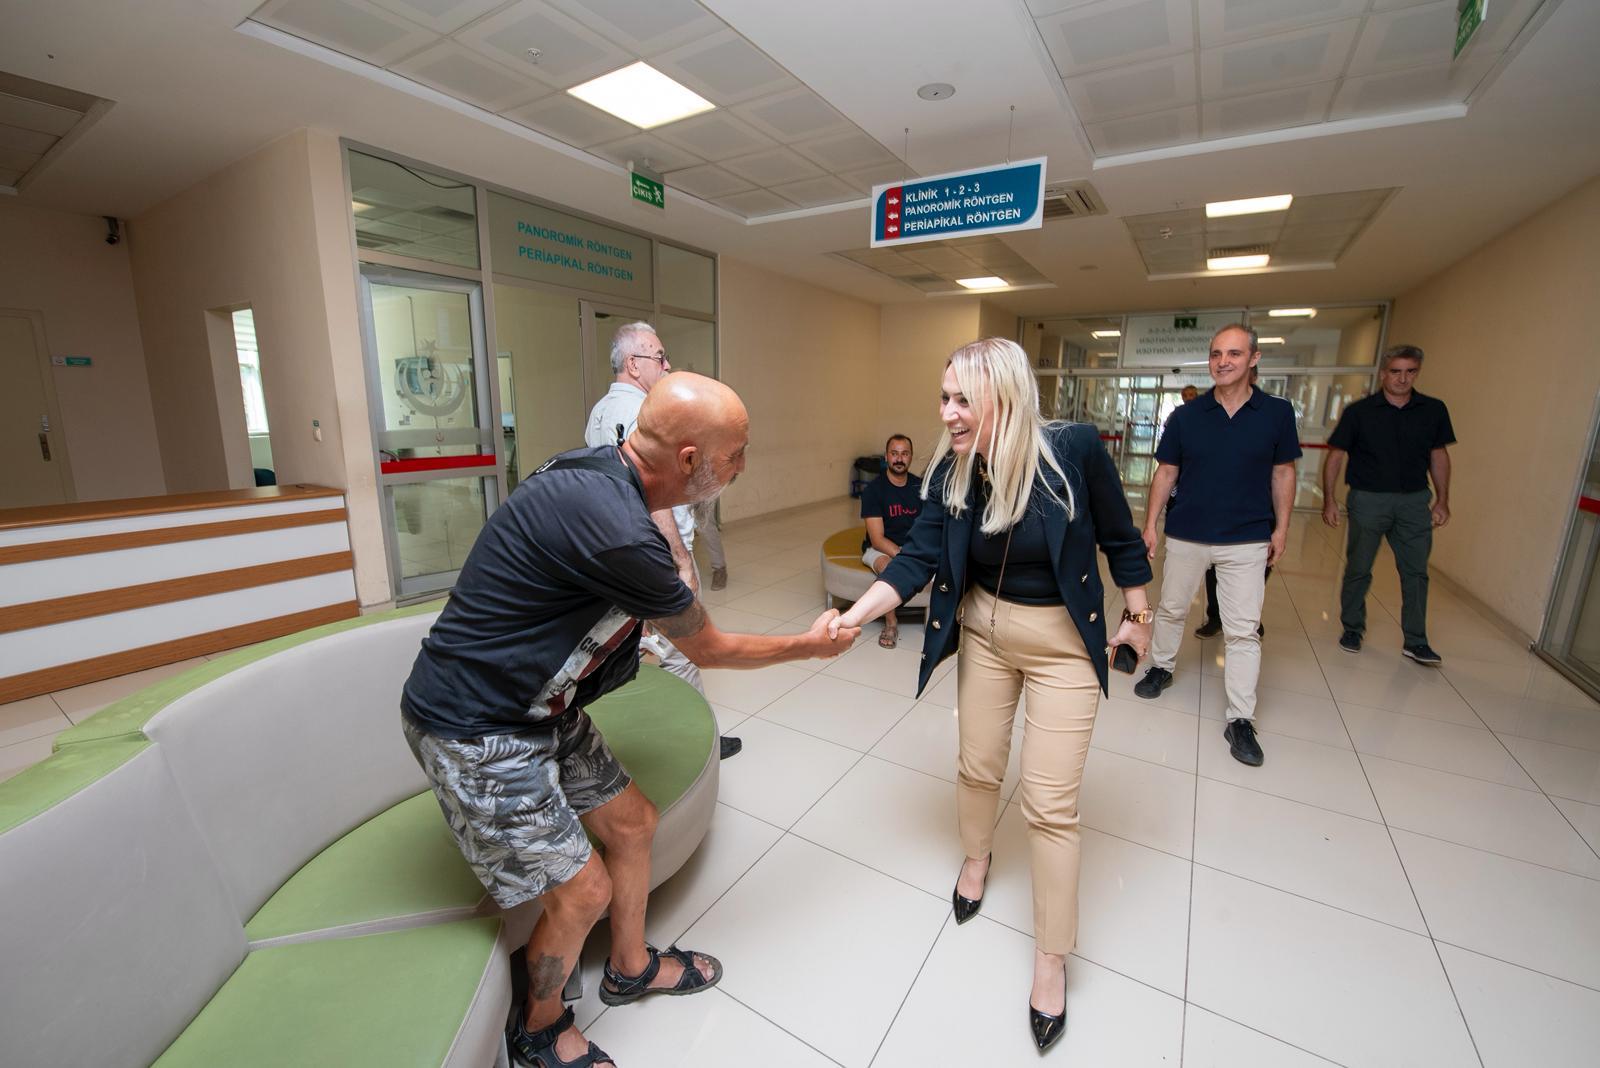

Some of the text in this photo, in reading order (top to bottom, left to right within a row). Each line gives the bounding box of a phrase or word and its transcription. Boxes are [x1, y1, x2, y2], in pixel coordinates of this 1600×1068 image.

[633, 186, 653, 200] ÇIKIŞ
[905, 188, 938, 203] KLİNİK
[944, 188, 950, 197] 1
[959, 185, 965, 195] 2
[974, 183, 980, 193] 3
[905, 193, 1014, 216] PANOROMİK RÖNTGEN
[904, 208, 1021, 232] PERİAPİKAL RÖNTGEN
[518, 222, 632, 260] PANOROMİK RÖNTGEN
[519, 246, 633, 281] PERİAPİKAL RÖNTGEN
[580, 636, 603, 655] CA
